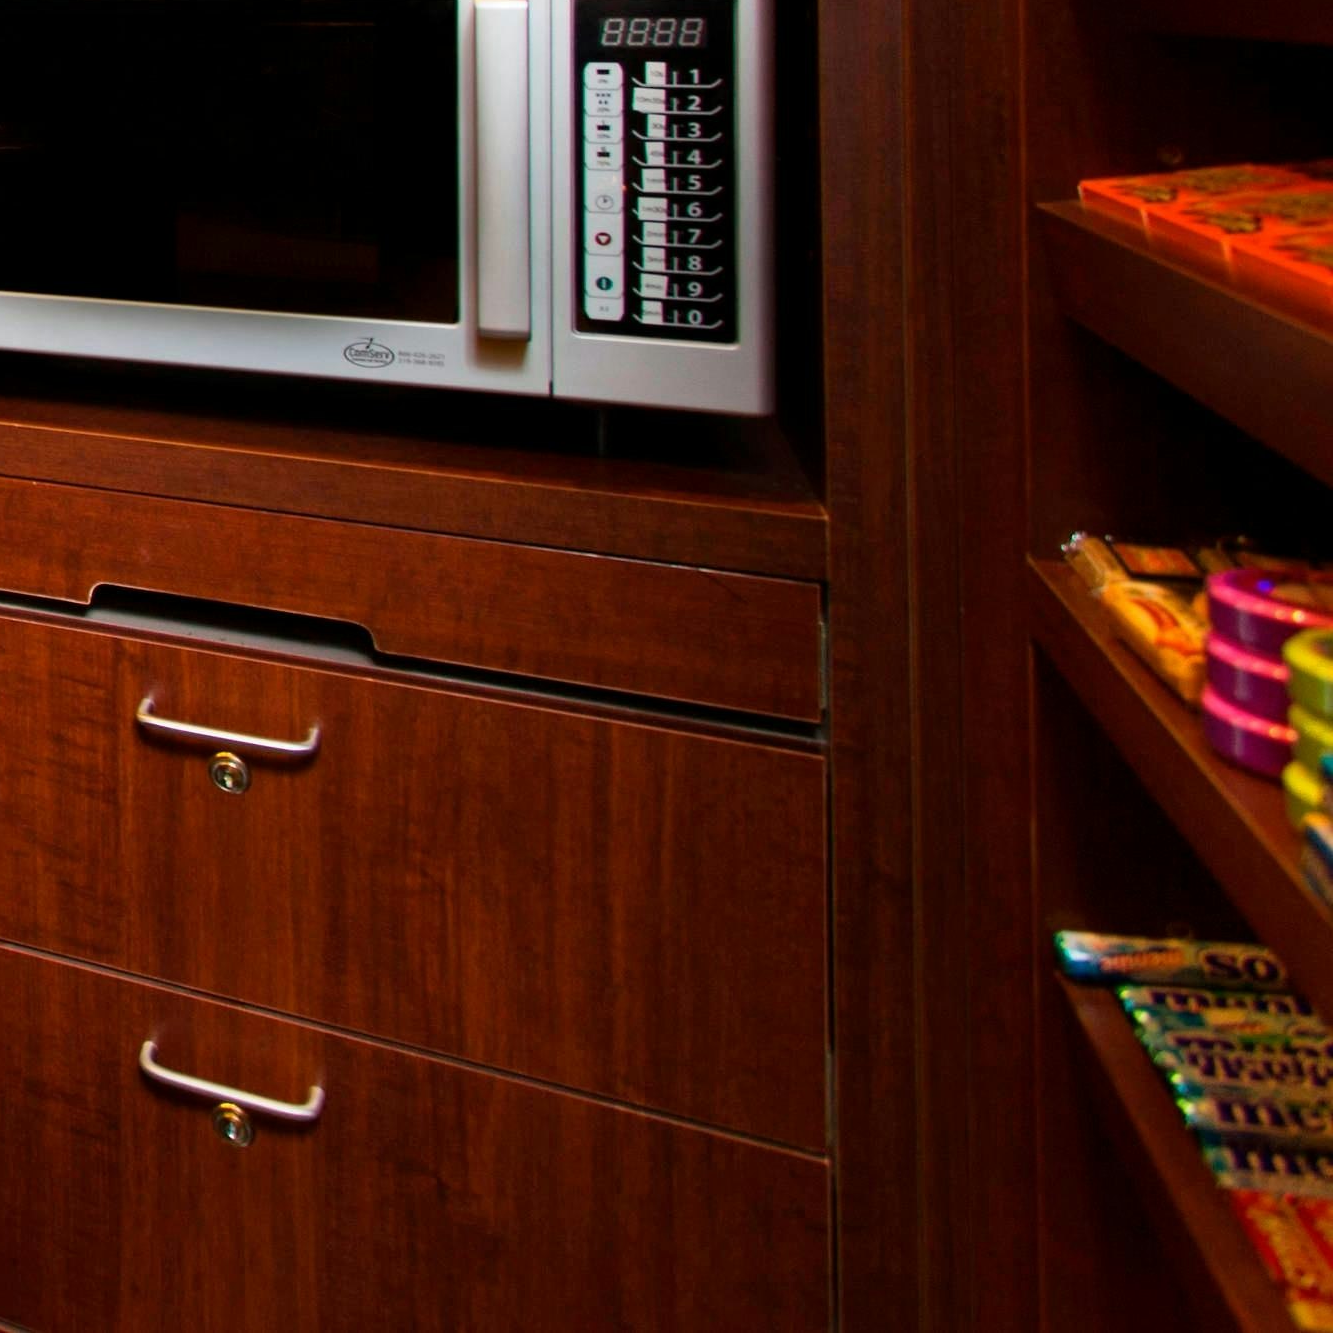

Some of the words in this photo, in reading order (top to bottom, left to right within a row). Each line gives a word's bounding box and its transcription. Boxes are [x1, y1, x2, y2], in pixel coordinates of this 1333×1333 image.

[689, 68, 699, 84] 1
[687, 95, 702, 111] 2
[687, 122, 702, 138] 3
[686, 149, 702, 164] 4
[687, 175, 702, 190] 5
[687, 202, 702, 217] 6
[687, 228, 702, 244] 7
[687, 255, 702, 271] 8
[687, 282, 702, 297] 9
[687, 309, 702, 325] 0
